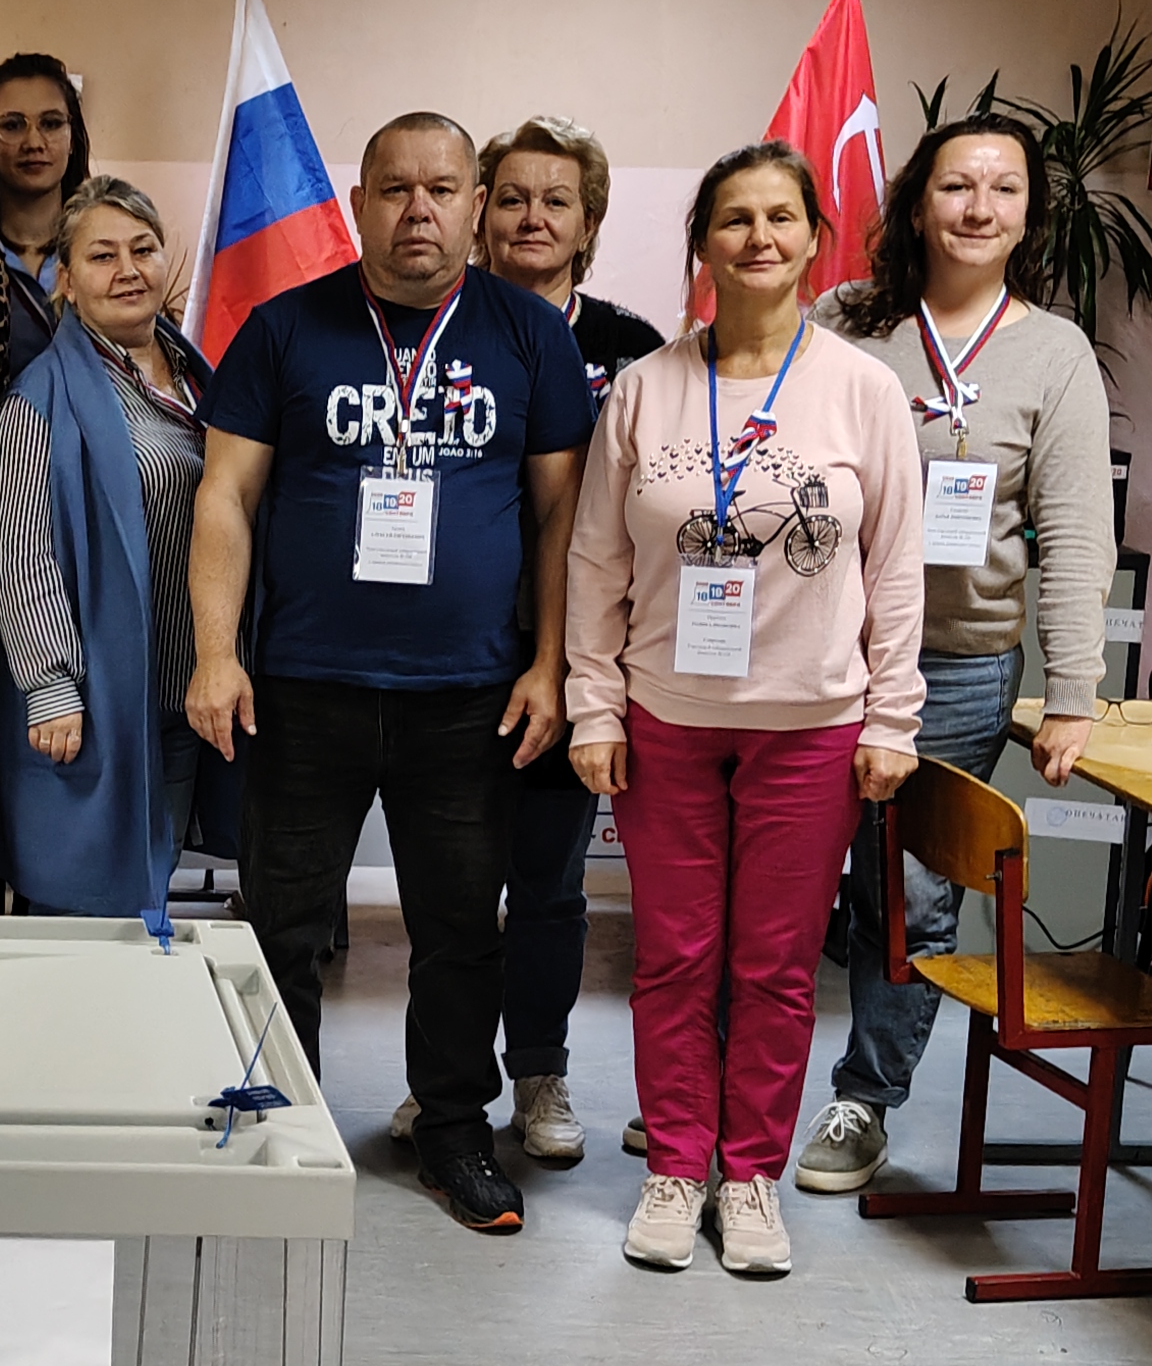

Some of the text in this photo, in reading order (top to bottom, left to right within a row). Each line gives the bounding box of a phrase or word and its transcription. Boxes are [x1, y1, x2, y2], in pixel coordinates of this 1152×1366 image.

[413, 446, 435, 466] UM
[382, 466, 433, 482] DUS
[399, 494, 413, 504] 20
[725, 584, 740, 594] 20
[1105, 618, 1144, 629] ПЕЧАТ
